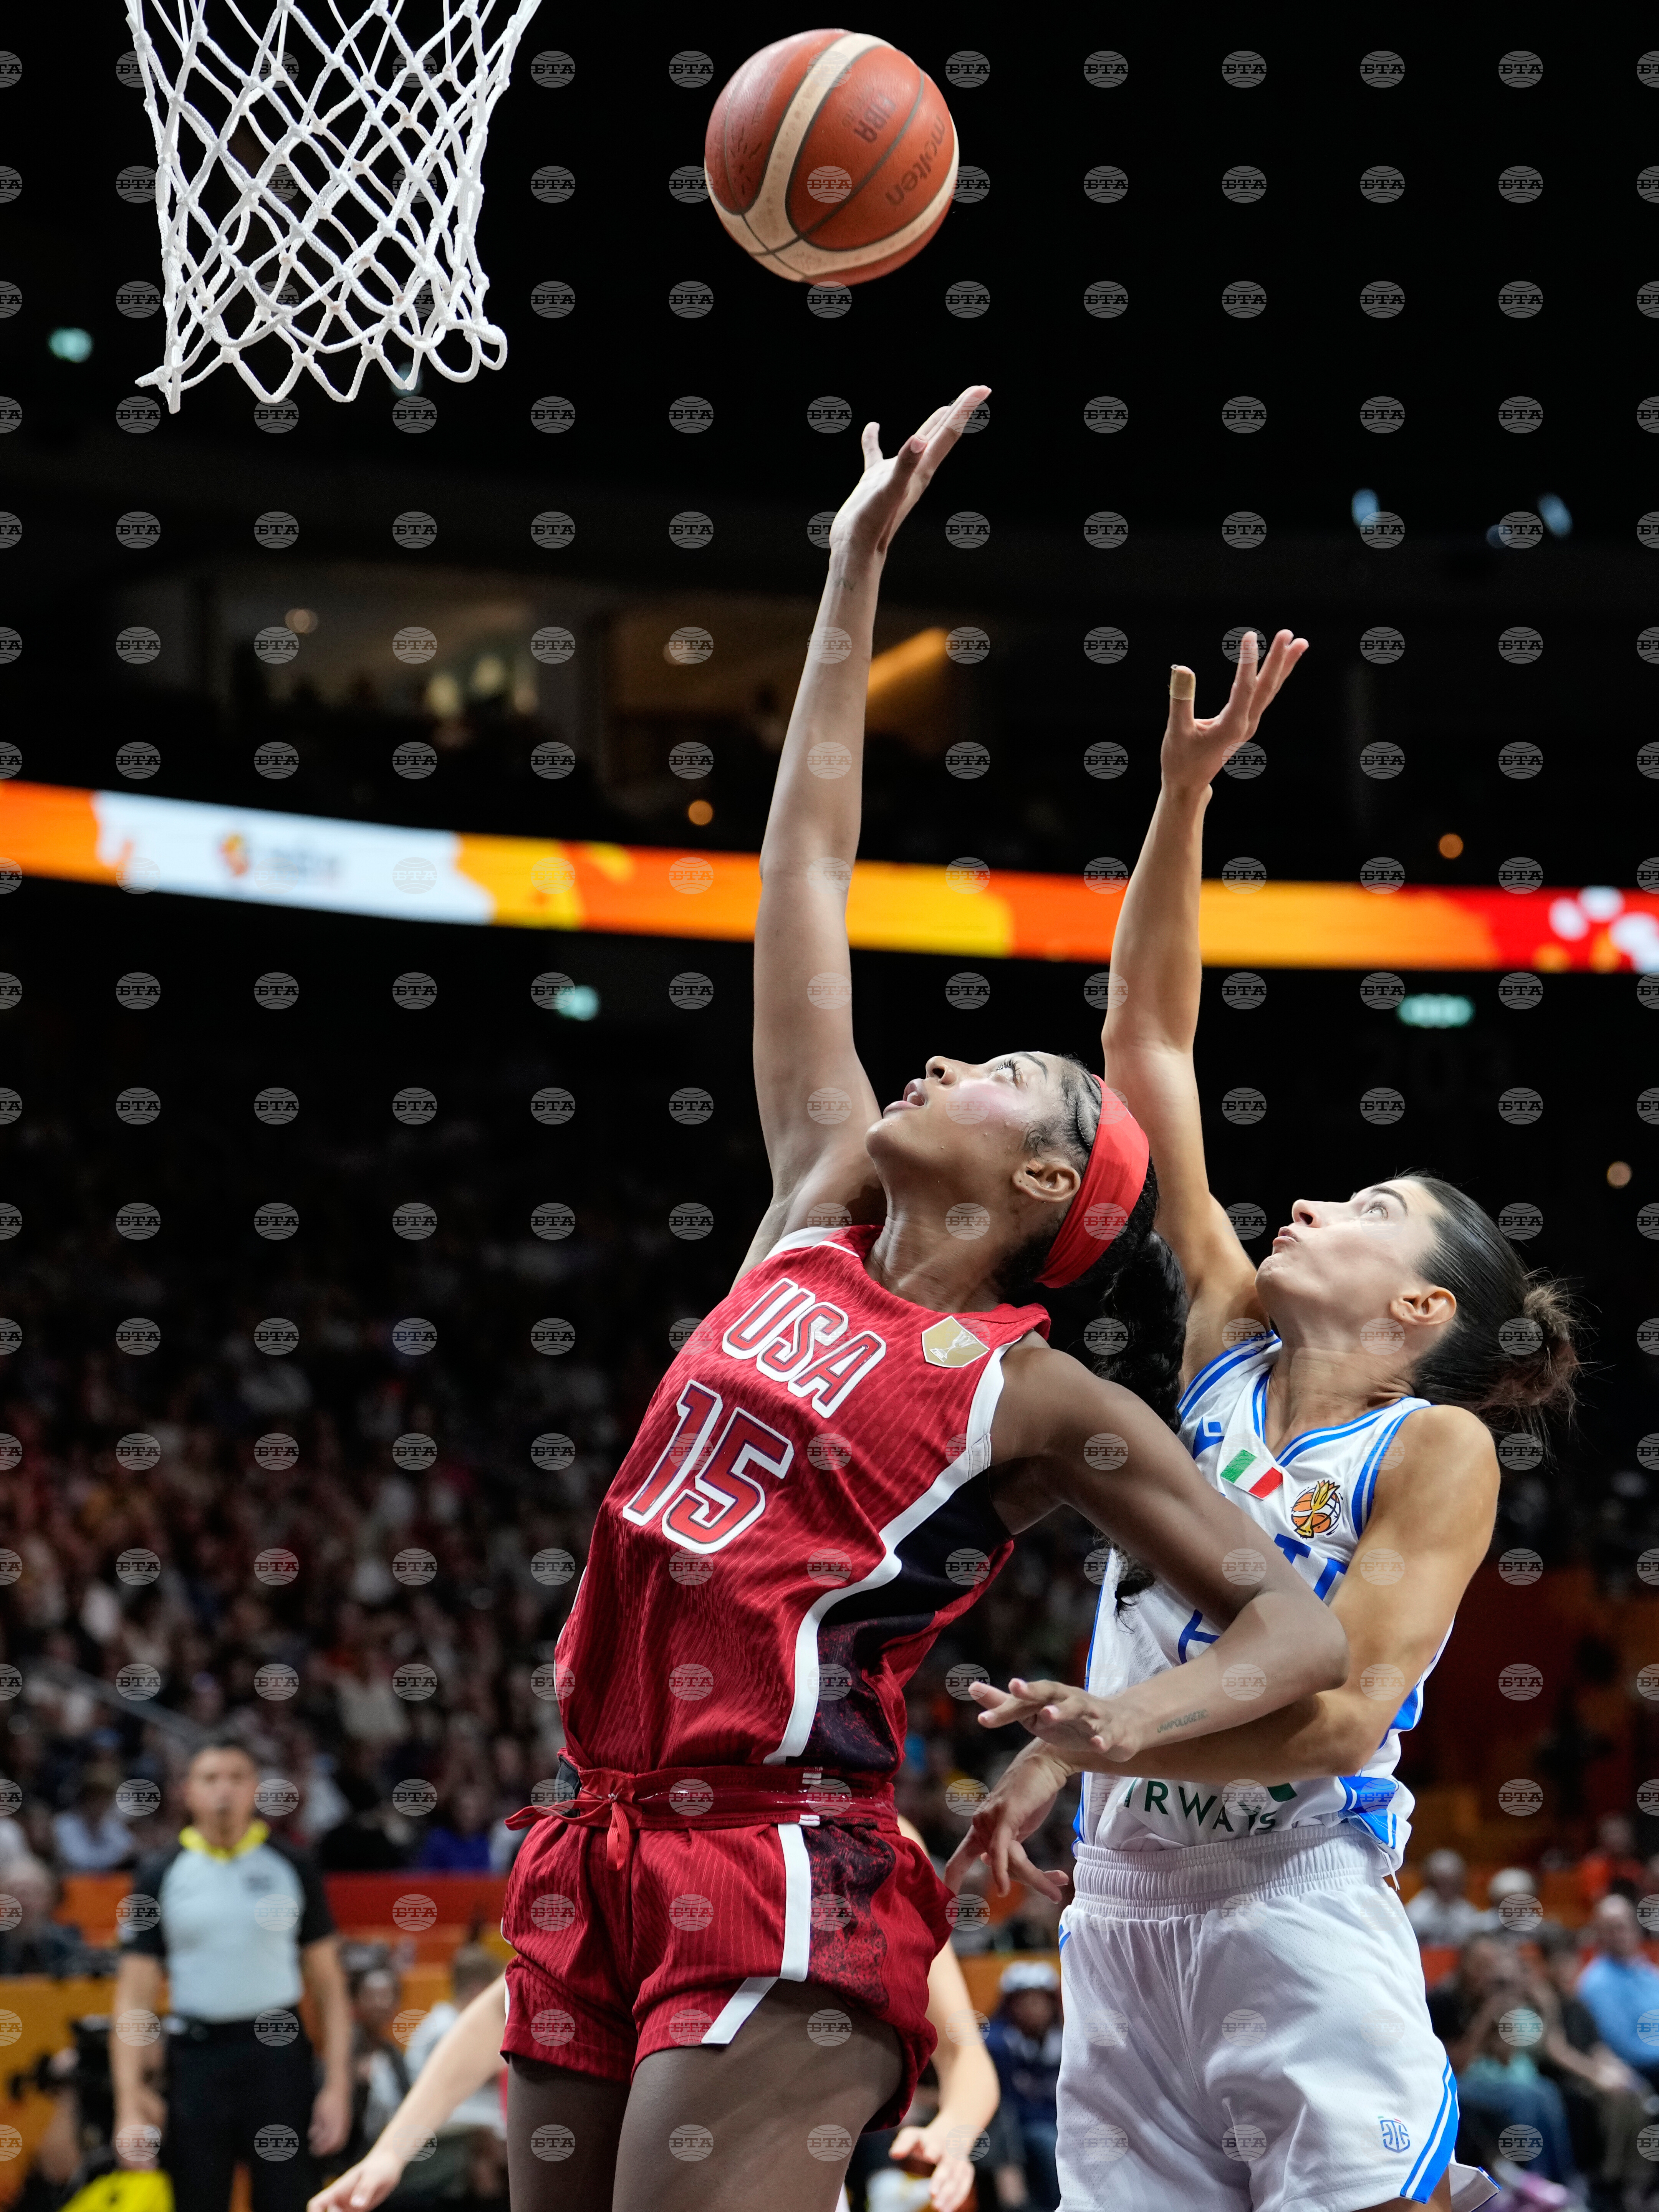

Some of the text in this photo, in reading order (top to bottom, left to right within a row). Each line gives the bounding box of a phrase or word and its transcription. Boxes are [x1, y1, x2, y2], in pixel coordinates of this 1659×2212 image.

[885, 114, 945, 205] molten
[722, 1278, 886, 1419] USA
[623, 1380, 795, 1554] 15
